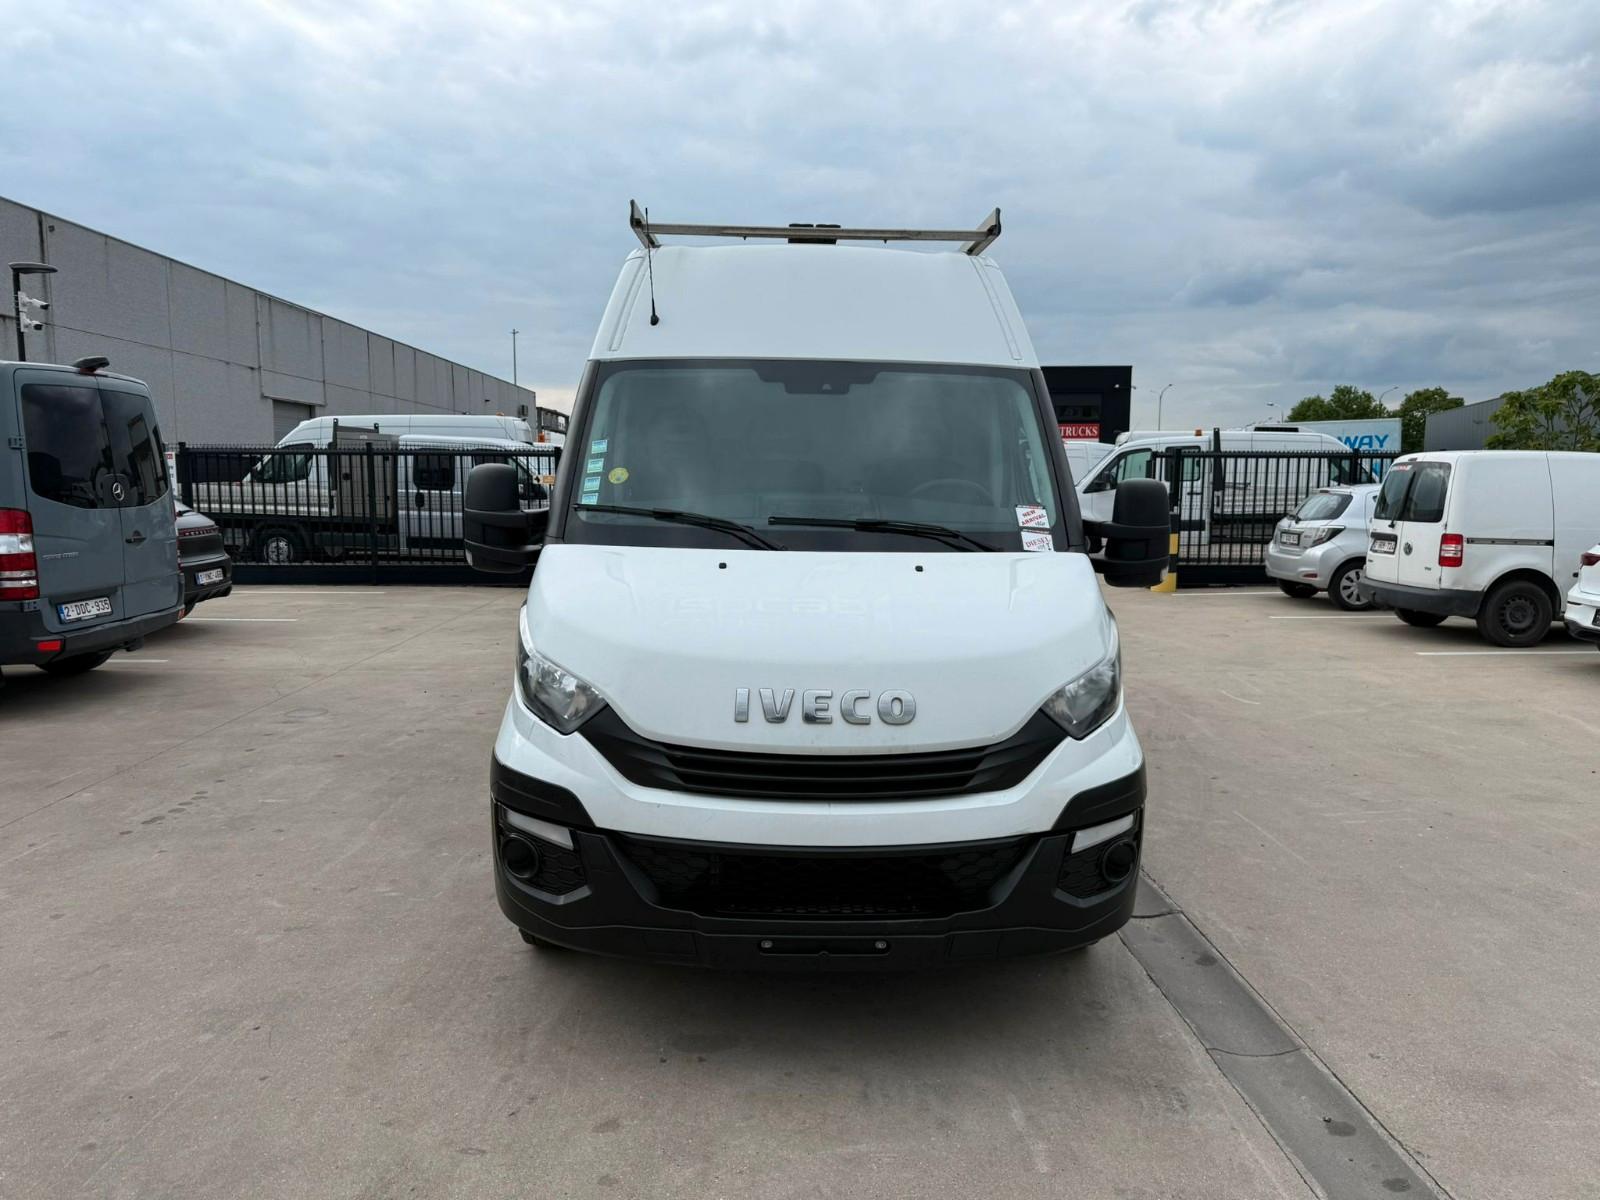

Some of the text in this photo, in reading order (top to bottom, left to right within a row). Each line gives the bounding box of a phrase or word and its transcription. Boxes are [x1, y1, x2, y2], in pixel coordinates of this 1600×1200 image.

[1059, 426, 1098, 437] TRUCKS
[1337, 434, 1389, 449] WAY
[1021, 513, 1047, 526] ARRIVAL
[1025, 536, 1050, 548] DIESEL
[64, 599, 110, 617] 2-DDC-935
[734, 687, 917, 725] IVECO
